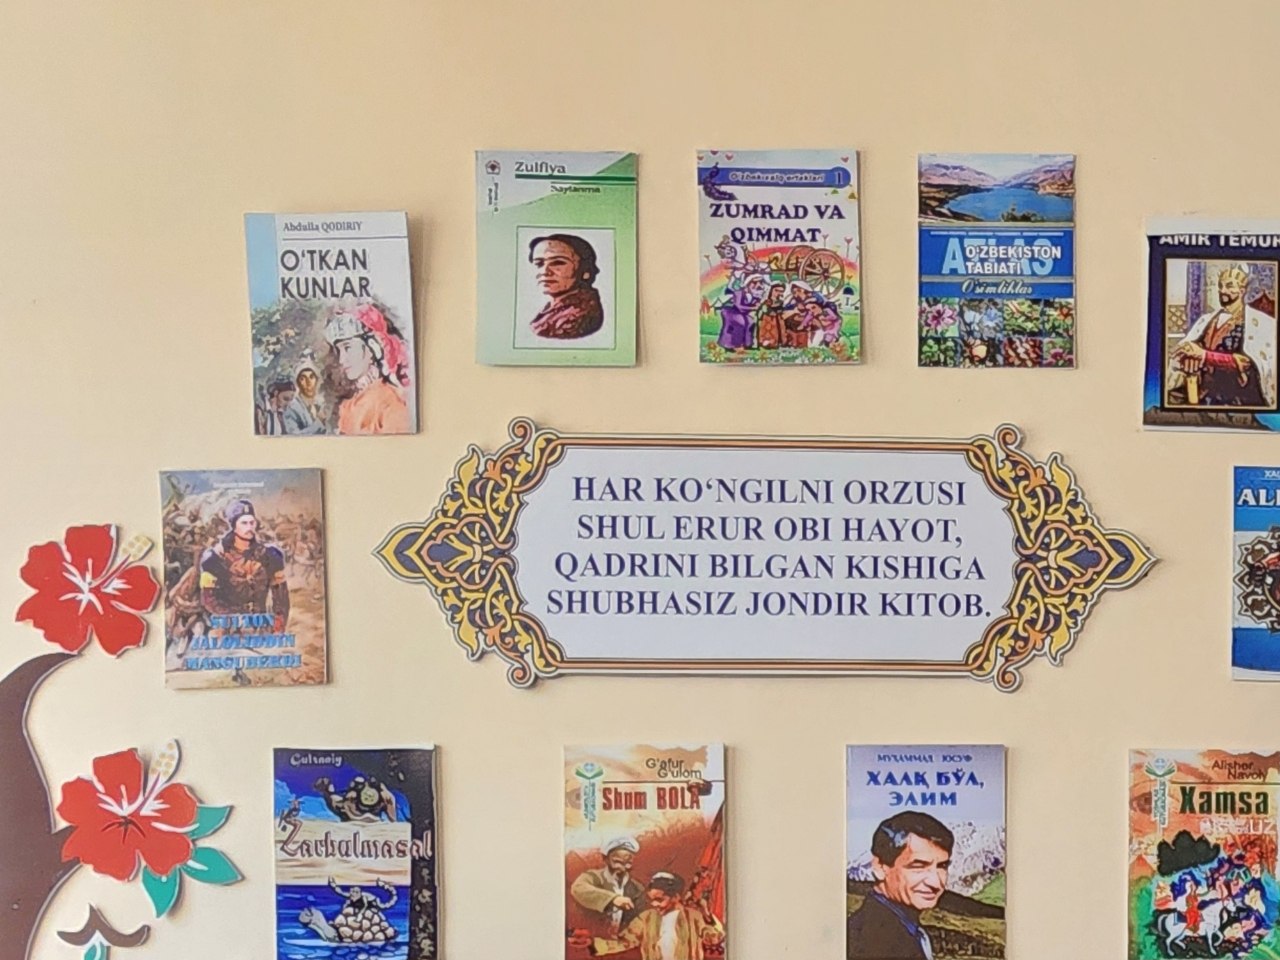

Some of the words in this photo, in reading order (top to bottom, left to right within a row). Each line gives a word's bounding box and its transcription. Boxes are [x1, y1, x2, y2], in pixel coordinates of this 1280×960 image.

[515, 161, 566, 175] Zulfiya
[709, 203, 808, 219] ZUMRAD
[814, 204, 846, 219] VA
[283, 221, 319, 232] Abdulla
[321, 220, 363, 233] QODIRIY
[730, 227, 821, 244] QIMMAT
[280, 248, 367, 271] O‘TKAN
[966, 245, 1061, 259] O'ZBEKISTON
[966, 261, 1020, 275] TABIATI
[280, 276, 371, 299] KUNLAR
[572, 476, 643, 502] HAR
[653, 477, 834, 504] KO‘NGILNI
[843, 480, 966, 505] ORZUSI
[577, 514, 665, 540] SHUL
[673, 516, 766, 541] ERUR
[774, 517, 831, 542] OBI
[842, 518, 963, 547] HAYOT,
[555, 551, 700, 582] QADRINI
[709, 554, 835, 579] BILGAN
[845, 556, 986, 580] KISHIGA
[546, 590, 738, 616] SHUBHASIZ
[745, 591, 870, 616] JONDIR
[878, 592, 992, 617] KITOB.
[866, 770, 930, 789] ХАЛҚ
[936, 768, 985, 789] БЎЛ,
[602, 786, 647, 811] Shum
[657, 786, 701, 811] BOLA
[889, 791, 957, 806] ЭЛИМ
[1179, 786, 1269, 815] Xamsa
